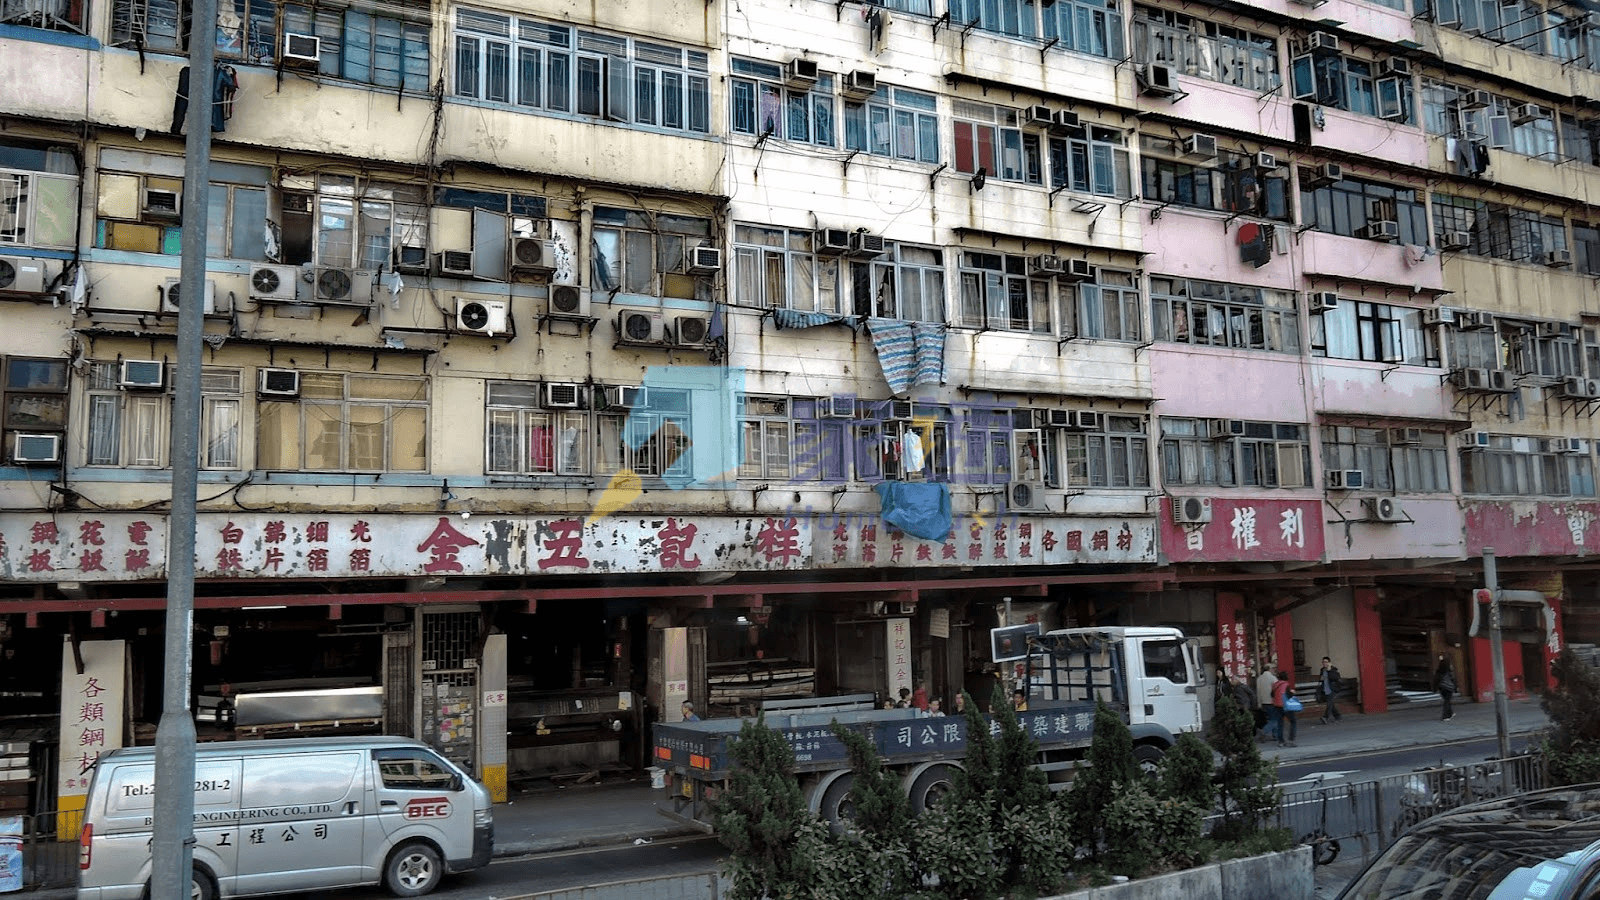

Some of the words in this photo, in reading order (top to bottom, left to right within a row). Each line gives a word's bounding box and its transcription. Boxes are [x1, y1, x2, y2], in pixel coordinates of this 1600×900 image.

[1041, 529, 1133, 552] 各國鋼材
[193, 807, 279, 823] ENGINEERING
[408, 804, 447, 818] BEC
